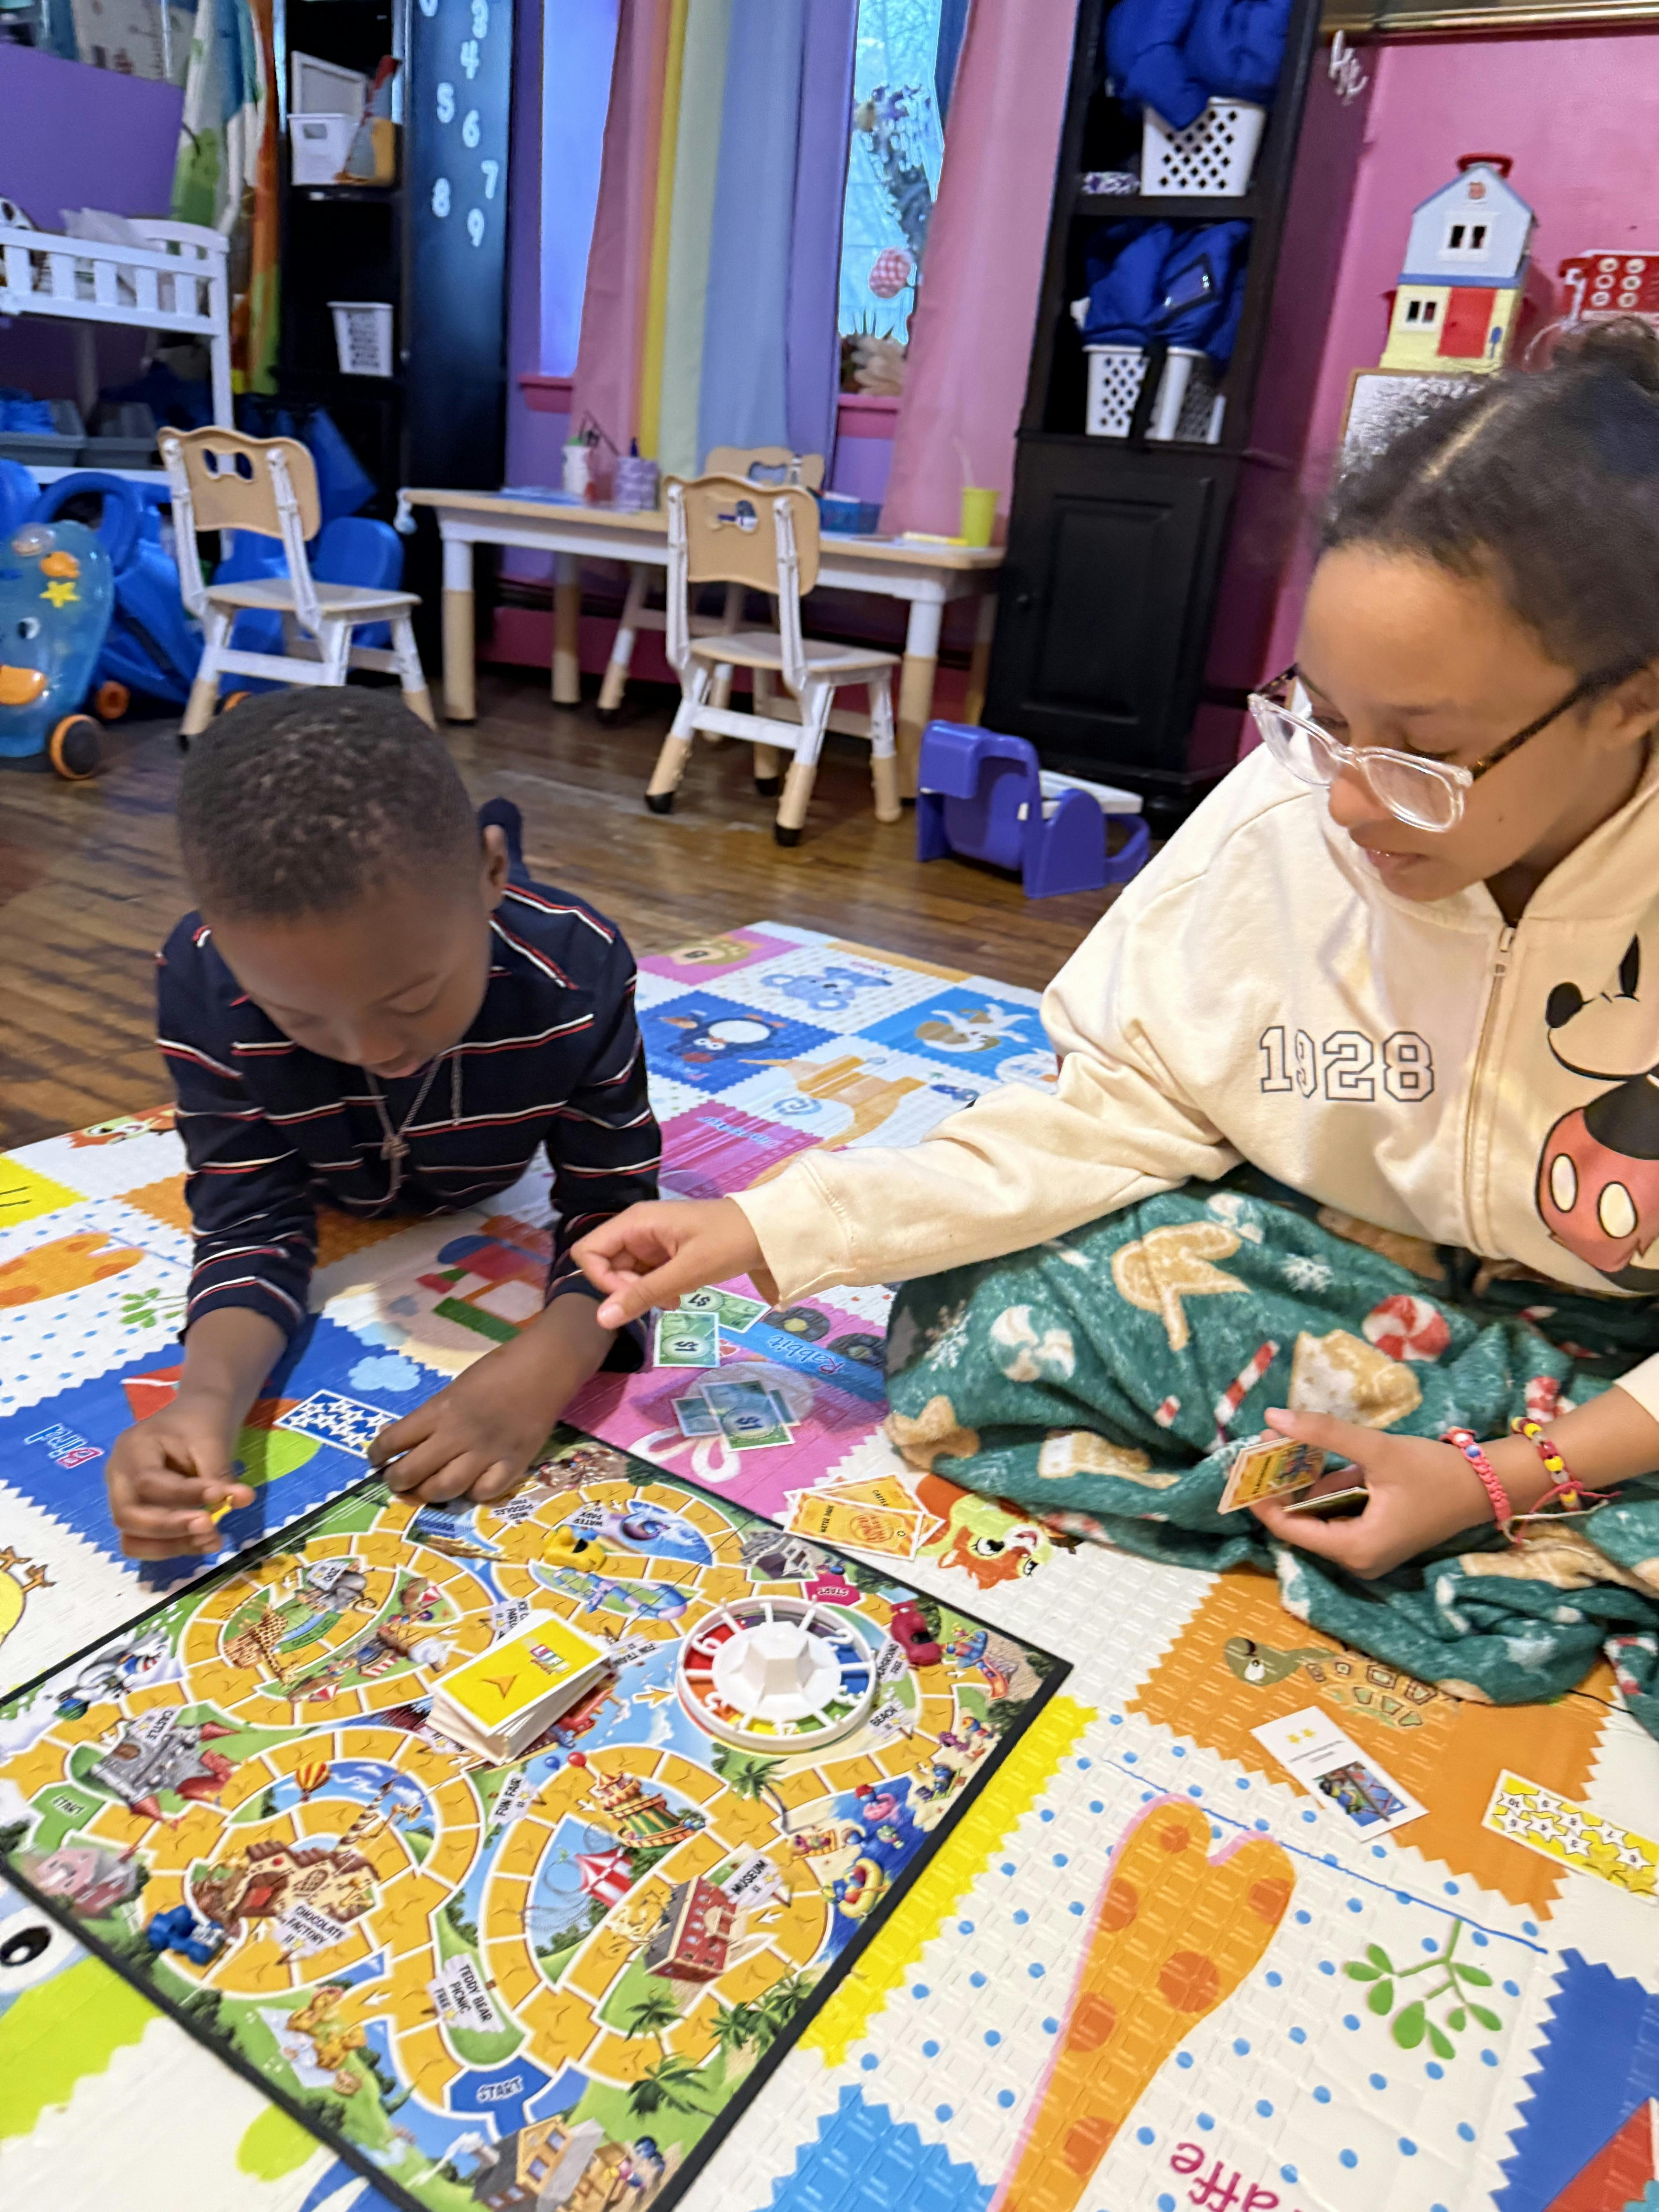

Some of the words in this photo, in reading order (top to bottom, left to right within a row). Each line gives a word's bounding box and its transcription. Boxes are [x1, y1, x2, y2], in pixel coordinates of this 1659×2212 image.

[460, 40, 479, 79] 4
[437, 82, 455, 123] 5
[462, 110, 480, 148] 6
[481, 160, 498, 199] 7
[432, 178, 451, 217] 8
[467, 208, 484, 247] 9
[1259, 1025, 1434, 1103] 1928
[687, 1293, 711, 1307] $1
[674, 1341, 699, 1352] $1
[767, 1336, 844, 1374] Rabbit
[733, 1416, 763, 1431] $1
[573, 1518, 603, 1527] WATER
[817, 1586, 849, 1597] START
[147, 1710, 174, 1740] CASTLE
[870, 1705, 898, 1727] BEACH
[495, 1798, 512, 1817] FUN
[504, 1778, 522, 1797] FAIR
[731, 1860, 768, 1895] MUSEUM
[284, 1917, 327, 1946] FACTORY
[295, 1905, 345, 1940] CHOCOLATE
[449, 1980, 471, 2014] PICNIC
[459, 1964, 481, 1995] TEDDY
[471, 1995, 493, 2023] BEAR
[476, 2075, 524, 2104] START
[1170, 2142, 1302, 2212] affe
